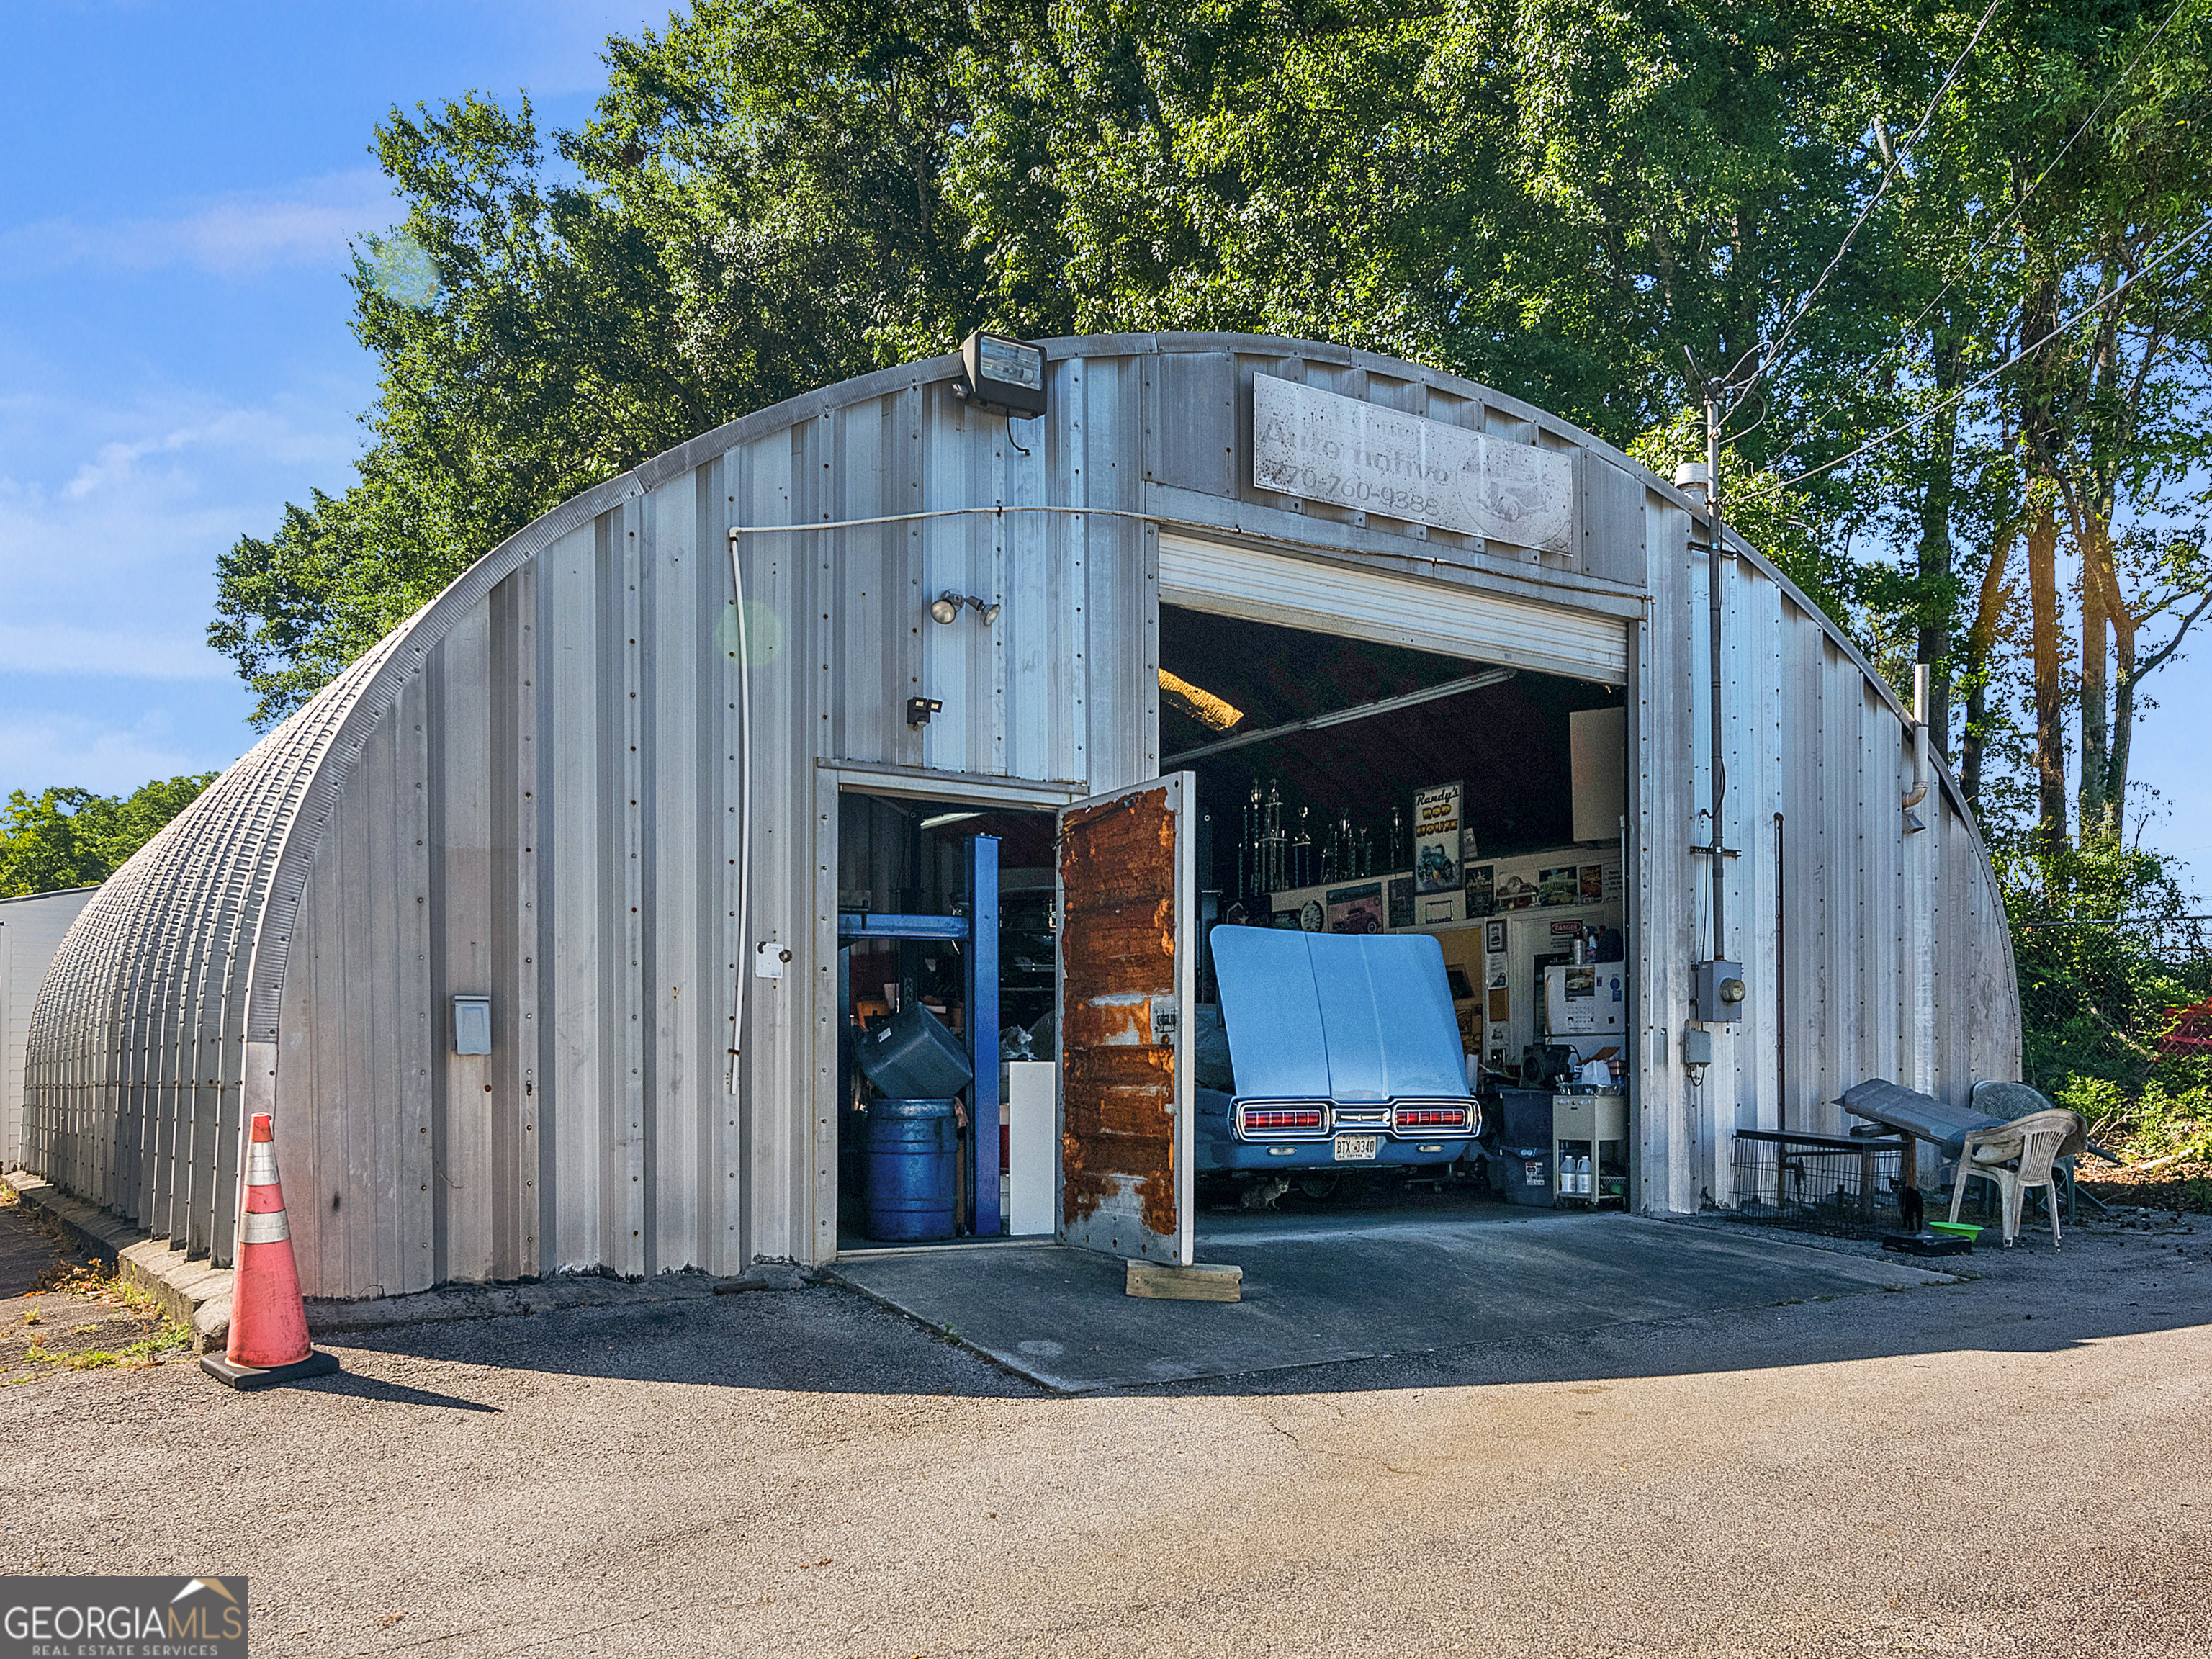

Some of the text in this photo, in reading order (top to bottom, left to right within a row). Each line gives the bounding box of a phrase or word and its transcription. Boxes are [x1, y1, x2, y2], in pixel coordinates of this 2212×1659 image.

[1269, 462, 1439, 516] 770-760-9388
[1416, 786, 1459, 806] Randy's
[1423, 804, 1451, 820] ROD
[1416, 819, 1458, 837] HOUSE
[1337, 1141, 1350, 1153] BTX
